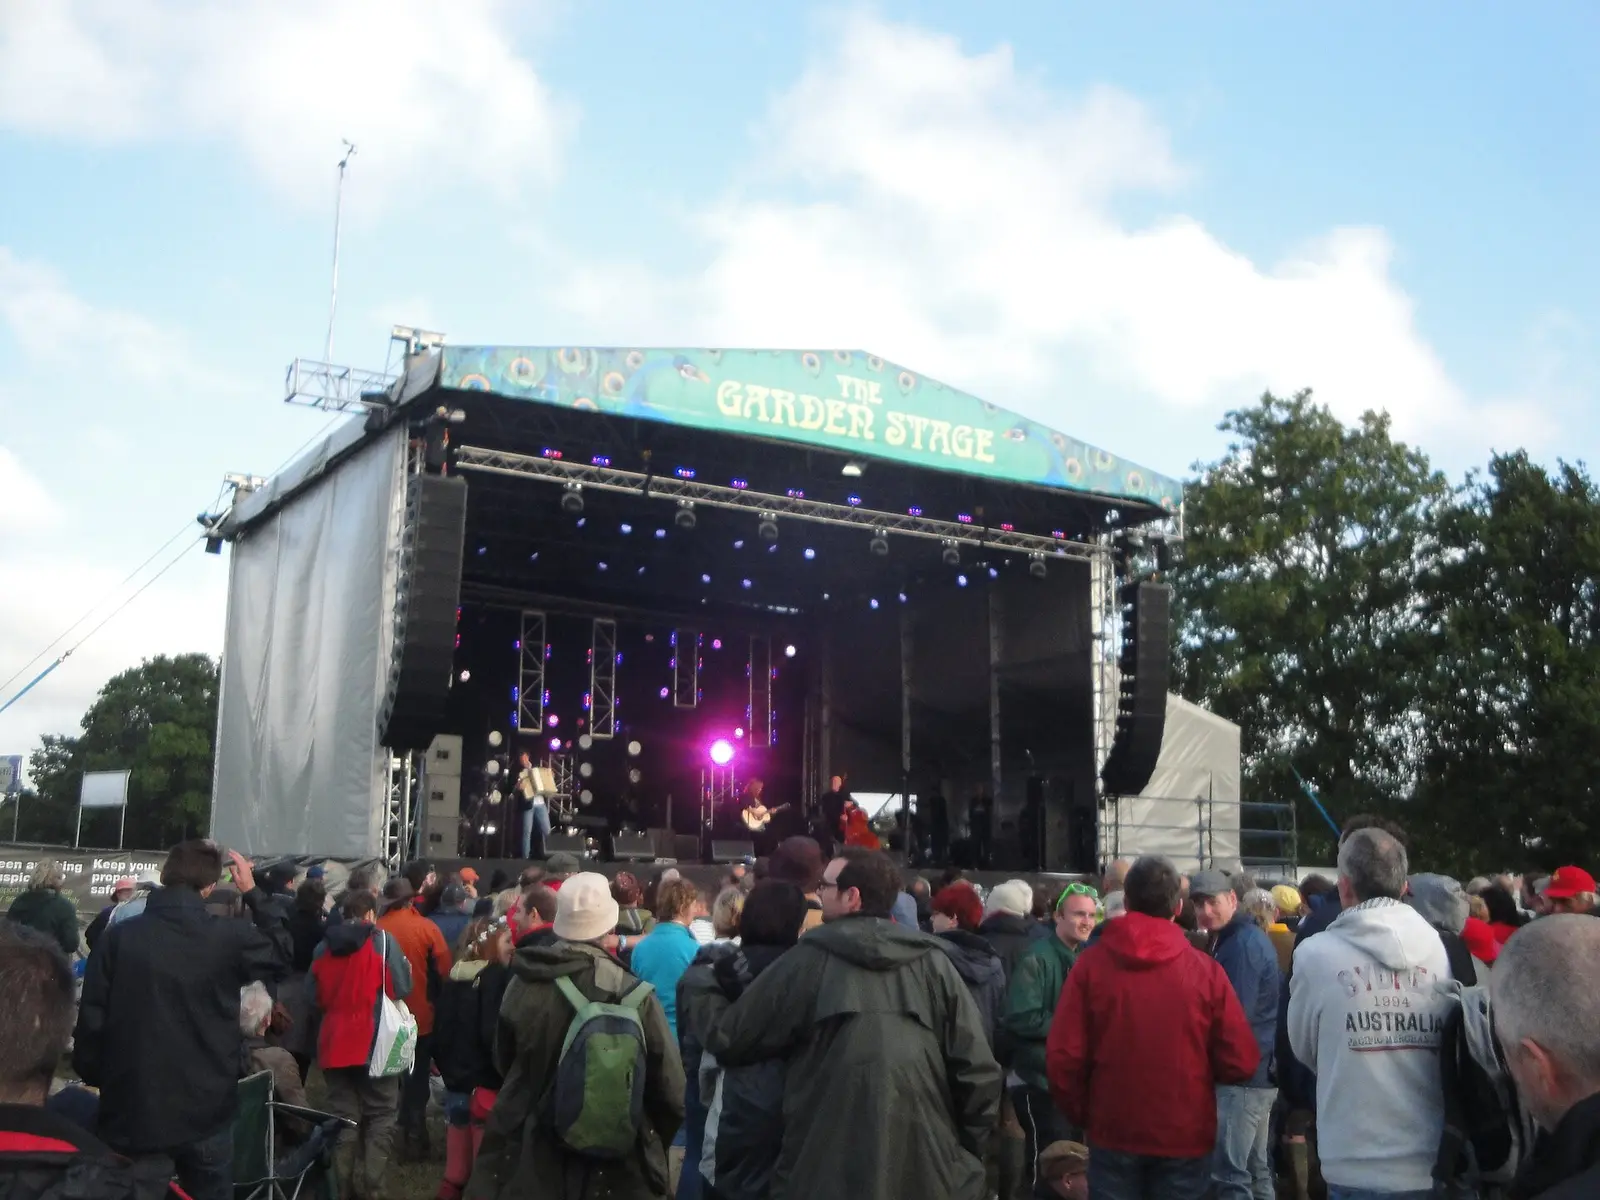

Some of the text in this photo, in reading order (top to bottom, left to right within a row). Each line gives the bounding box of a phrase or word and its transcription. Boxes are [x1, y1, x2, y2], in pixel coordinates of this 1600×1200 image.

[836, 374, 883, 405] THE
[716, 380, 995, 463] GARDEN STAGE
[93, 858, 158, 872] Keep your
[1374, 996, 1411, 1008] 1994
